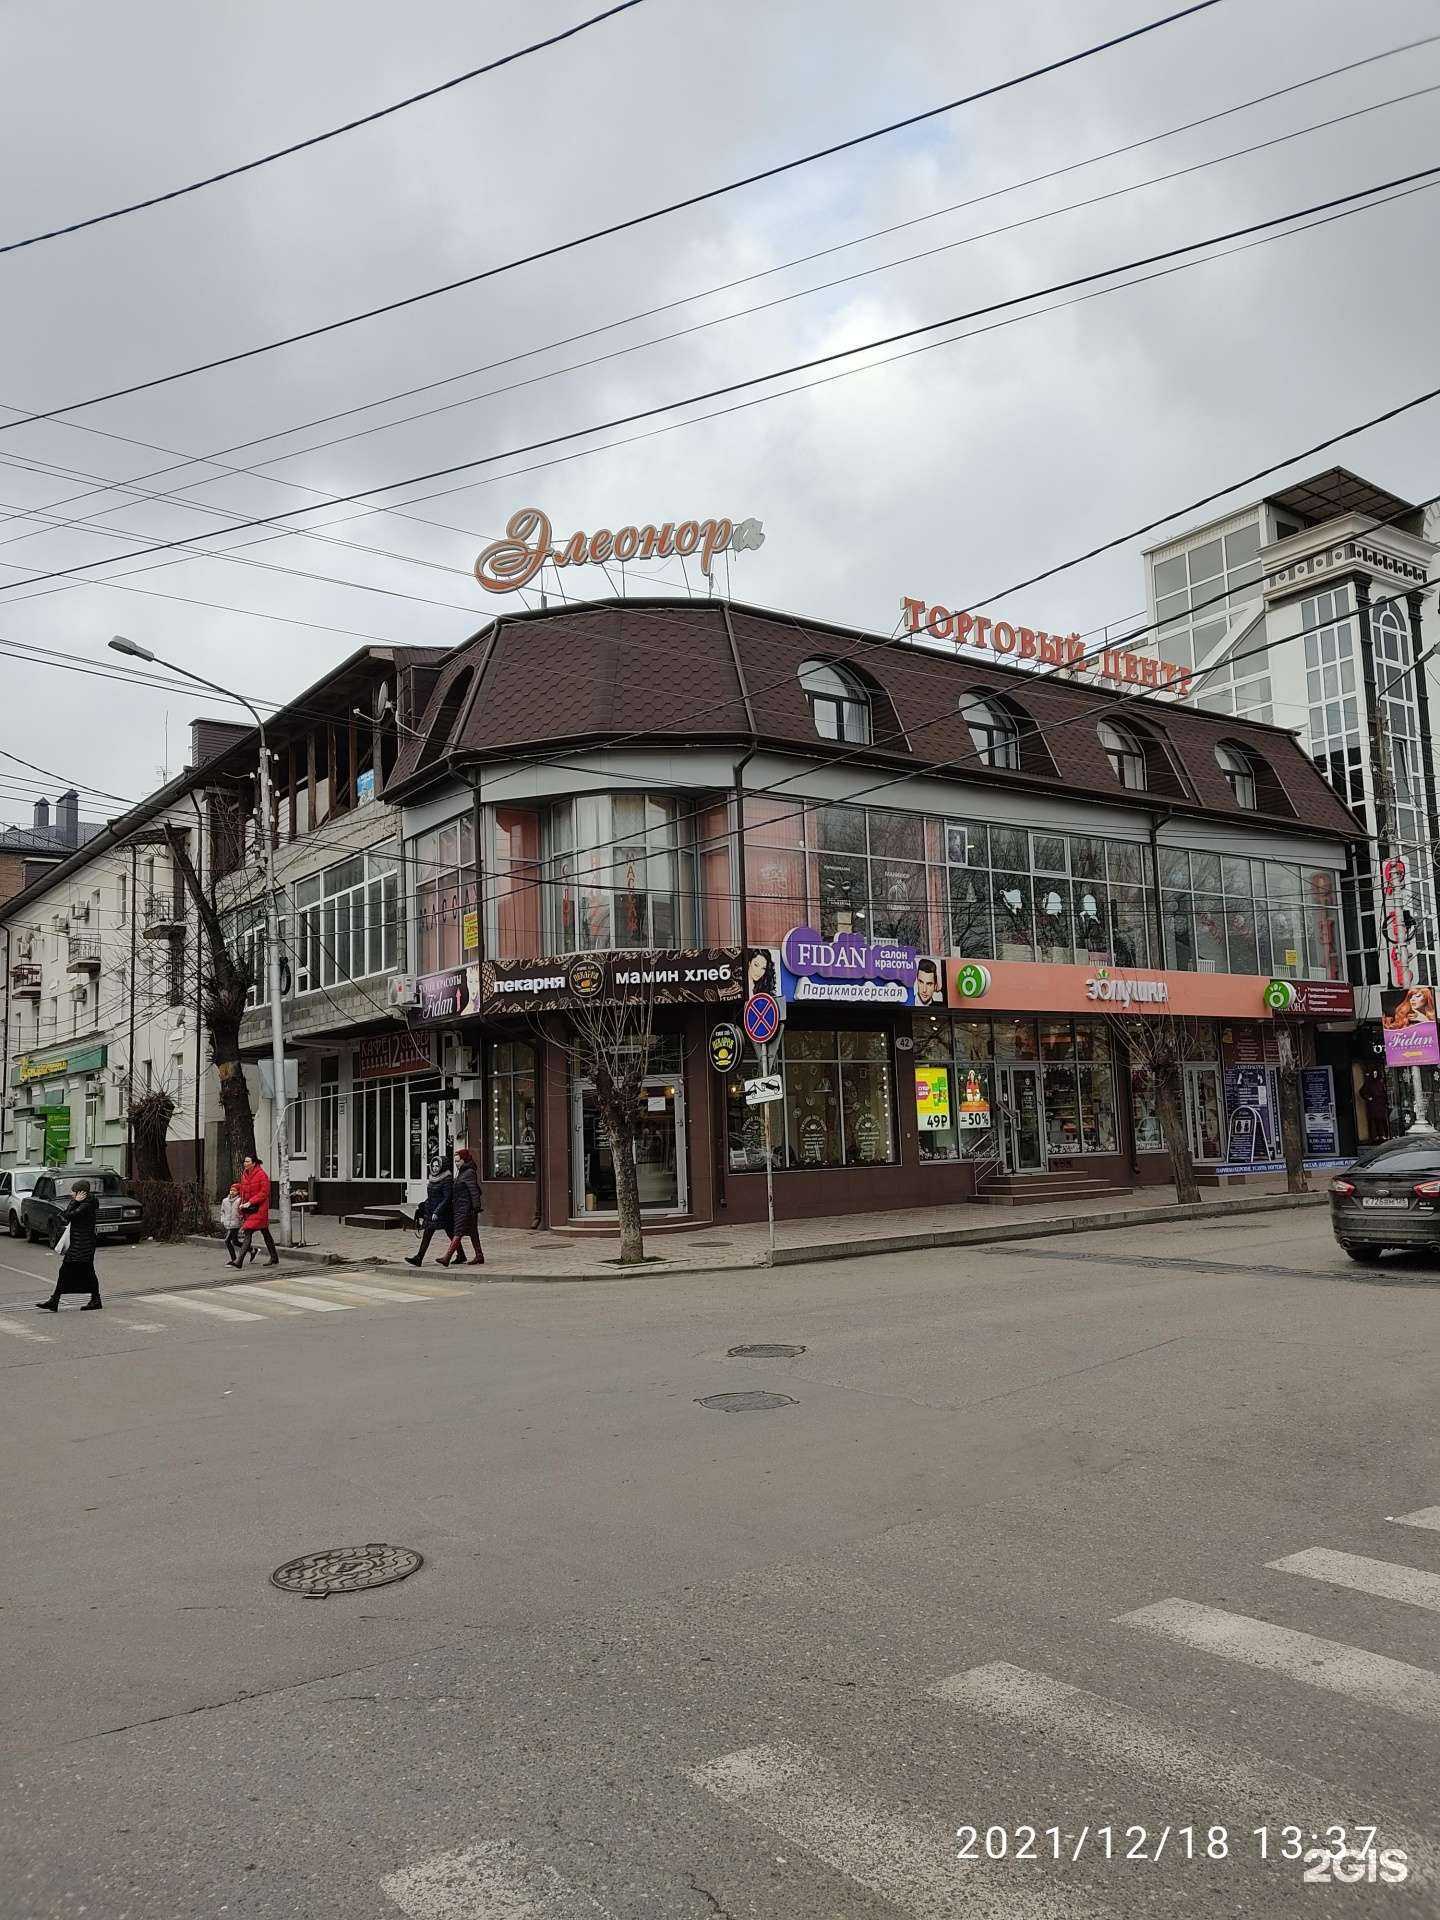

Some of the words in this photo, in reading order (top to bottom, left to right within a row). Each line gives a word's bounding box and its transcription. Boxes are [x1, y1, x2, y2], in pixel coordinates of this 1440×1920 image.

[902, 596, 1087, 672] ТОРГОВЫЙ
[1101, 649, 1193, 697] ЦЕНТР
[797, 943, 867, 968] FIDAN
[880, 950, 908, 960] салон
[874, 959, 914, 970] красоты
[615, 969, 679, 985] мамин
[684, 964, 731, 982] хлеб
[493, 976, 566, 994] пекарня
[803, 983, 903, 998] Парикмахерская
[899, 1037, 910, 1047] 42
[1388, 1031, 1433, 1047] Fidan
